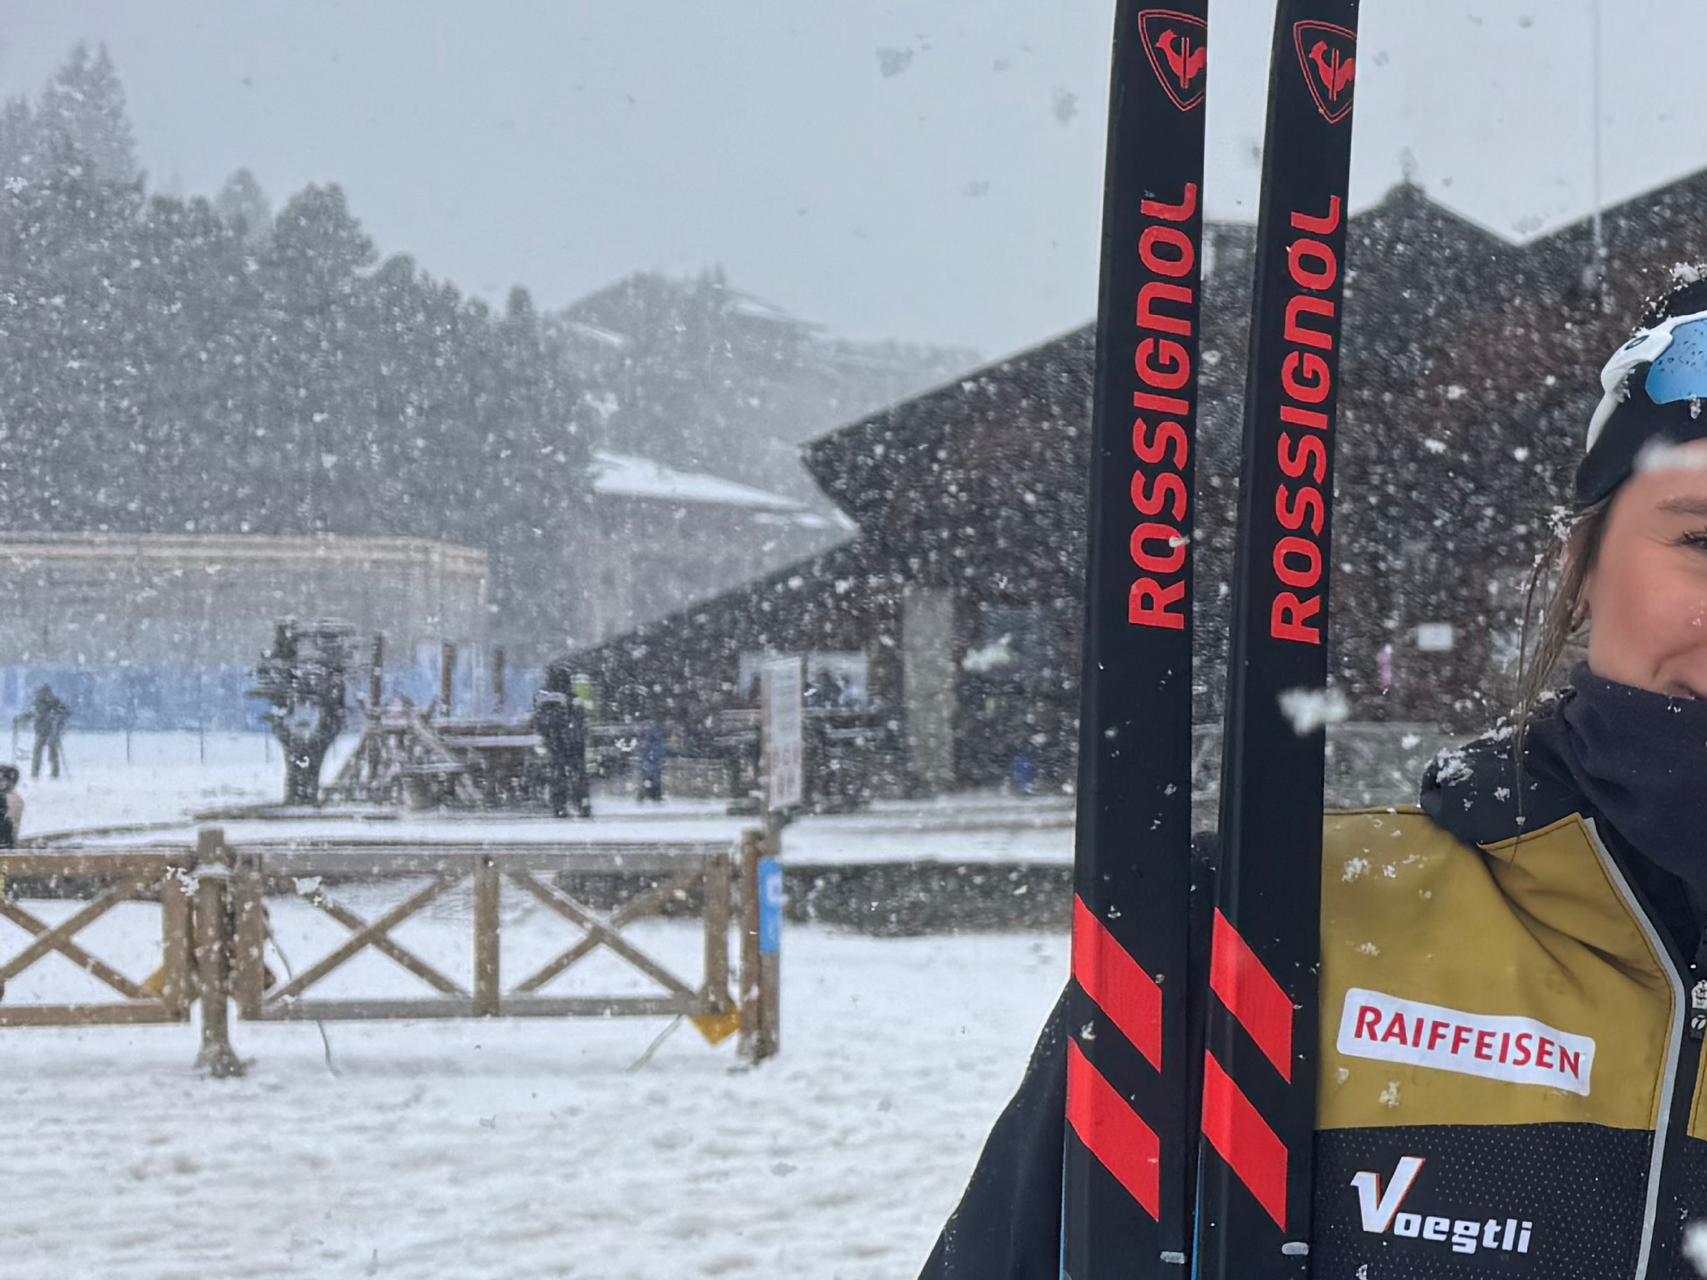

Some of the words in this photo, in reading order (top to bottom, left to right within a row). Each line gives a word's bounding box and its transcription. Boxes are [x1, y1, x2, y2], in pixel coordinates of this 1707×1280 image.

[1128, 181, 1197, 630] ROSSIGNOL
[1270, 195, 1341, 645] ROSSIGNOL
[1354, 1004, 1586, 1079] RAIFFEISEN
[1350, 1156, 1533, 1255] Voegtli
